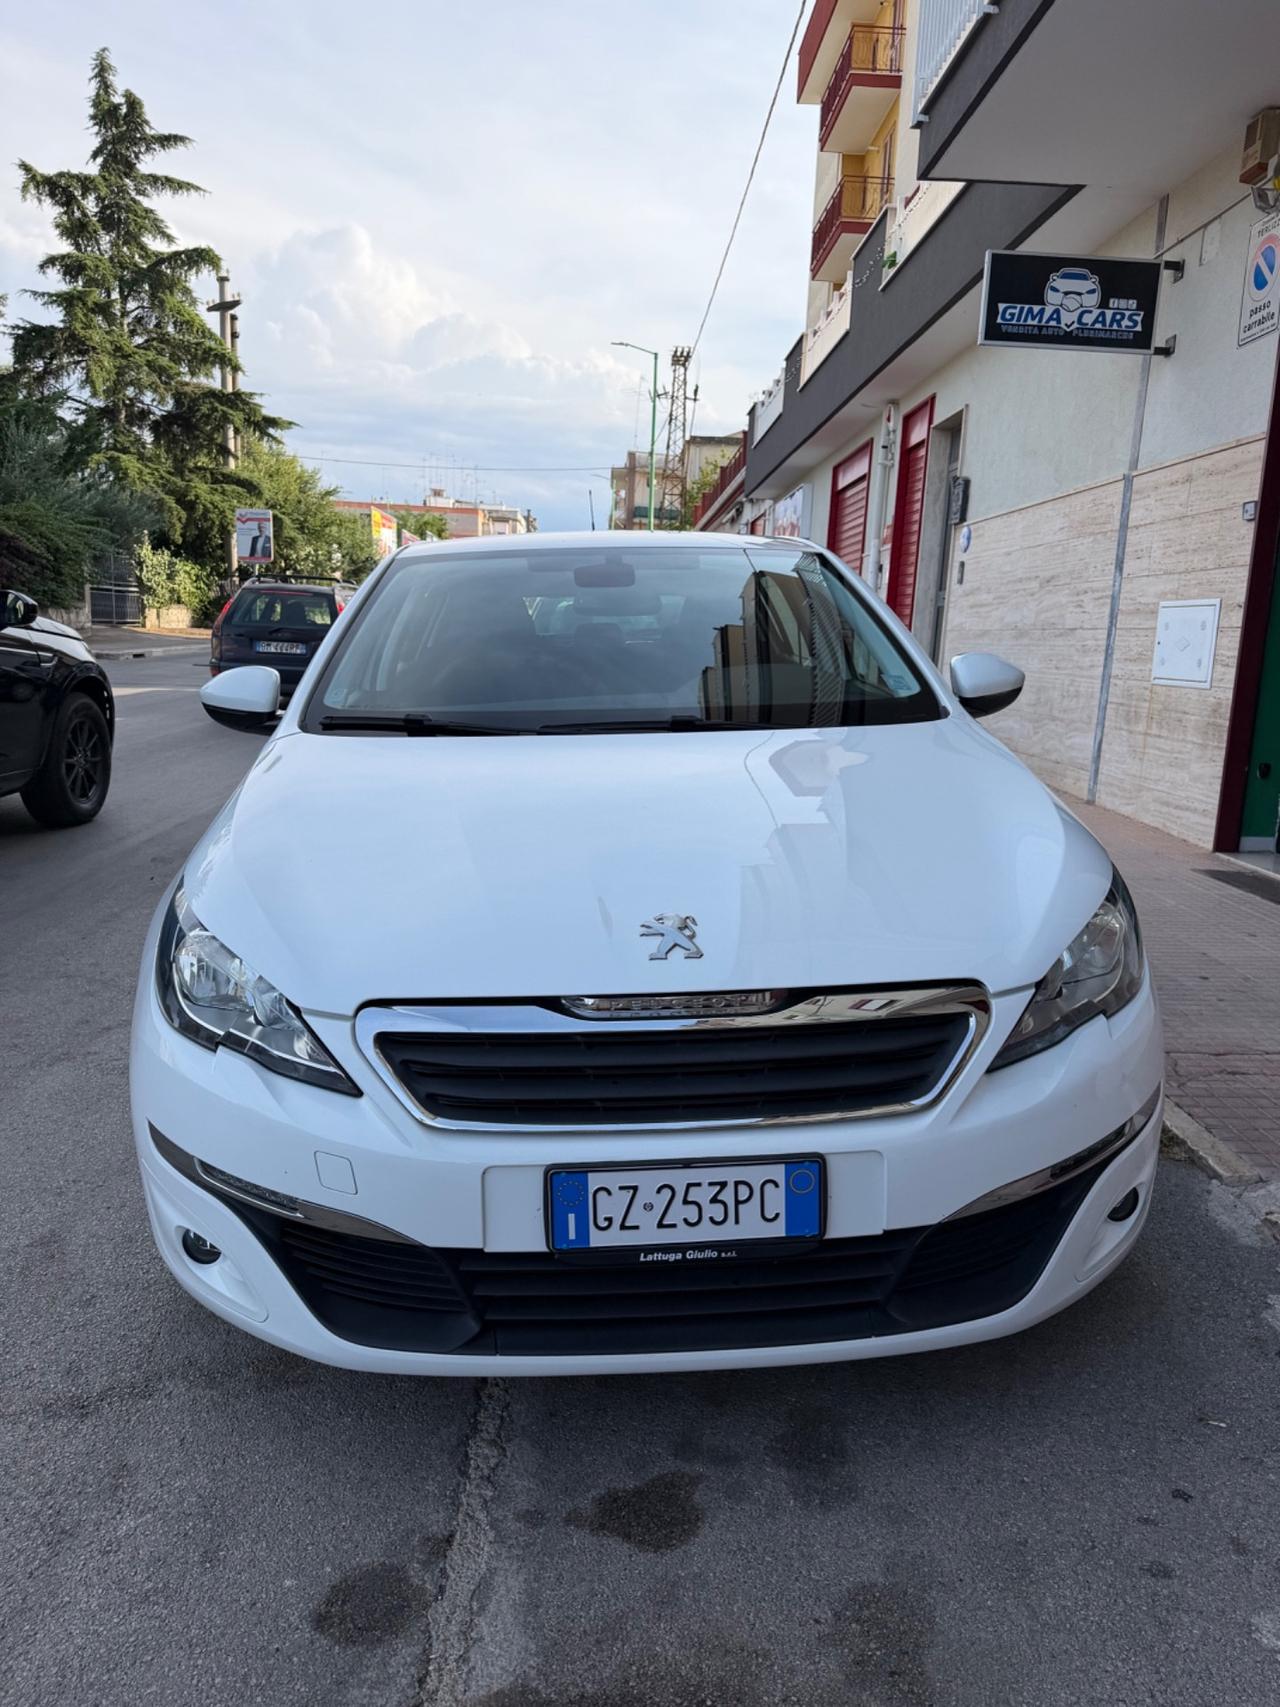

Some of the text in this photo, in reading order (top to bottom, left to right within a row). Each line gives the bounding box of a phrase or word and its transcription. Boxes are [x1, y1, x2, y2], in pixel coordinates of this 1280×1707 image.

[1000, 305, 1142, 329] GIMA CARS
[1250, 300, 1271, 320] passo
[1001, 324, 1039, 335] VENDITA
[1041, 327, 1065, 336] AUTO
[1243, 311, 1275, 333] carrabile
[640, 1252, 682, 1262] Lattuga
[686, 1249, 718, 1259] Giulio
